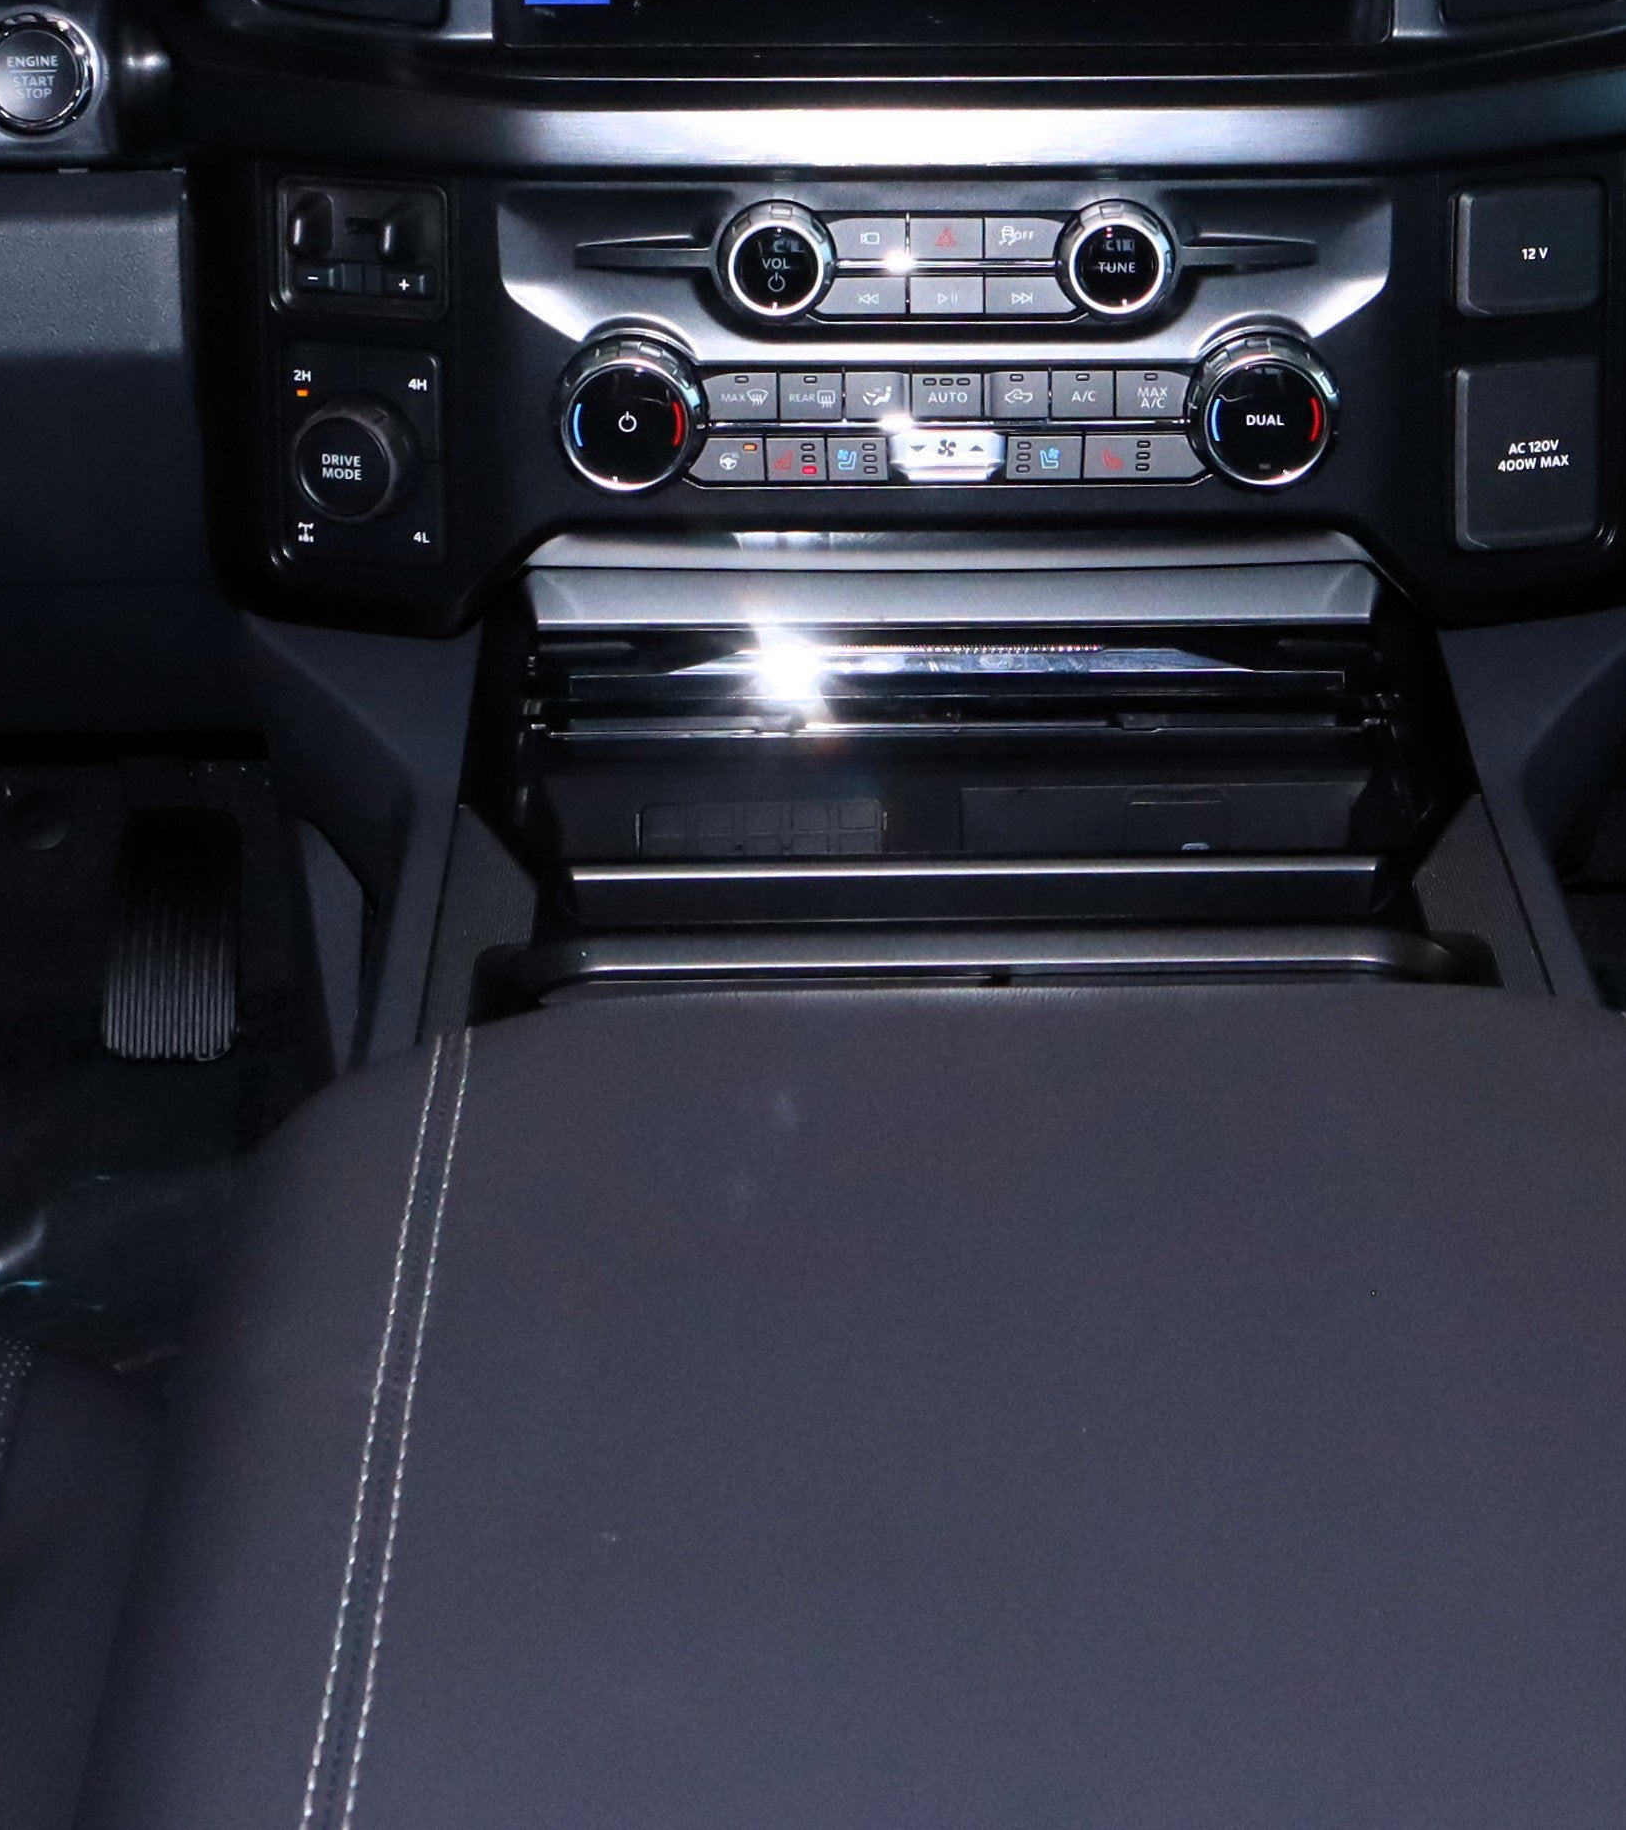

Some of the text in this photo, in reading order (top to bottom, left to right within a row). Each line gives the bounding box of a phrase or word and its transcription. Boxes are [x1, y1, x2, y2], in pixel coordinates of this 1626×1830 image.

[6, 55, 59, 68] ENGINE
[12, 75, 55, 87] START
[17, 88, 53, 99] STOP
[1521, 247, 1549, 260] 12 V
[762, 258, 791, 269] VOL
[1098, 262, 1136, 273] TUNE
[293, 369, 312, 382] 2H
[407, 378, 428, 392] 4H
[720, 393, 746, 403] MAX
[788, 393, 816, 403] REAR
[928, 392, 969, 404] AUTO
[1072, 390, 1097, 402] A/C
[1137, 387, 1168, 398] MAX
[1140, 397, 1166, 409] A/C
[1245, 414, 1285, 426] DUAL
[1508, 439, 1560, 455] AC 120V
[321, 453, 362, 468] DRIVE
[1497, 454, 1570, 472] 400W MAX
[322, 468, 362, 481] MODE
[413, 531, 431, 544] 4L
